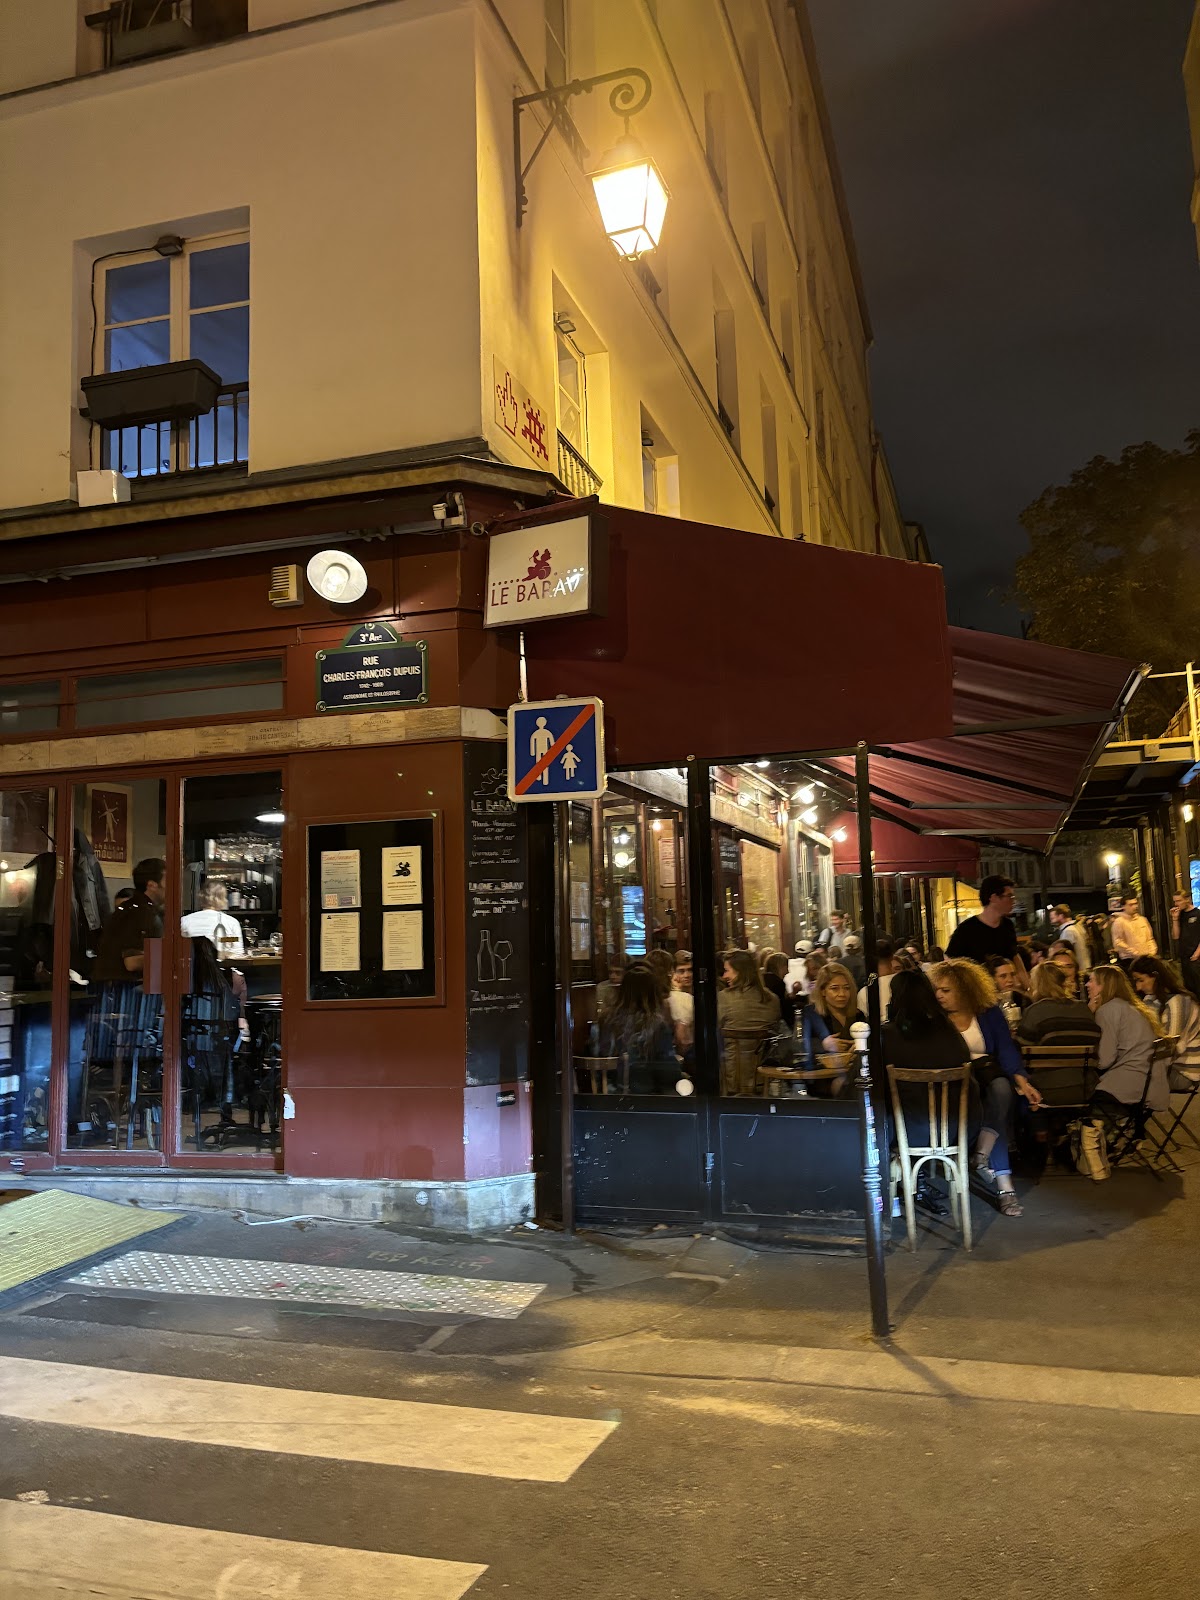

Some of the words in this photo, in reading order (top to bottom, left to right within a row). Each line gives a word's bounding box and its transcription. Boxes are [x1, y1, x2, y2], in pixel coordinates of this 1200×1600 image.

[491, 587, 509, 606] LE
[362, 656, 380, 666] RUE
[323, 668, 391, 683] CHARLES-FRANÇOIS
[393, 665, 421, 676] DUPUIS
